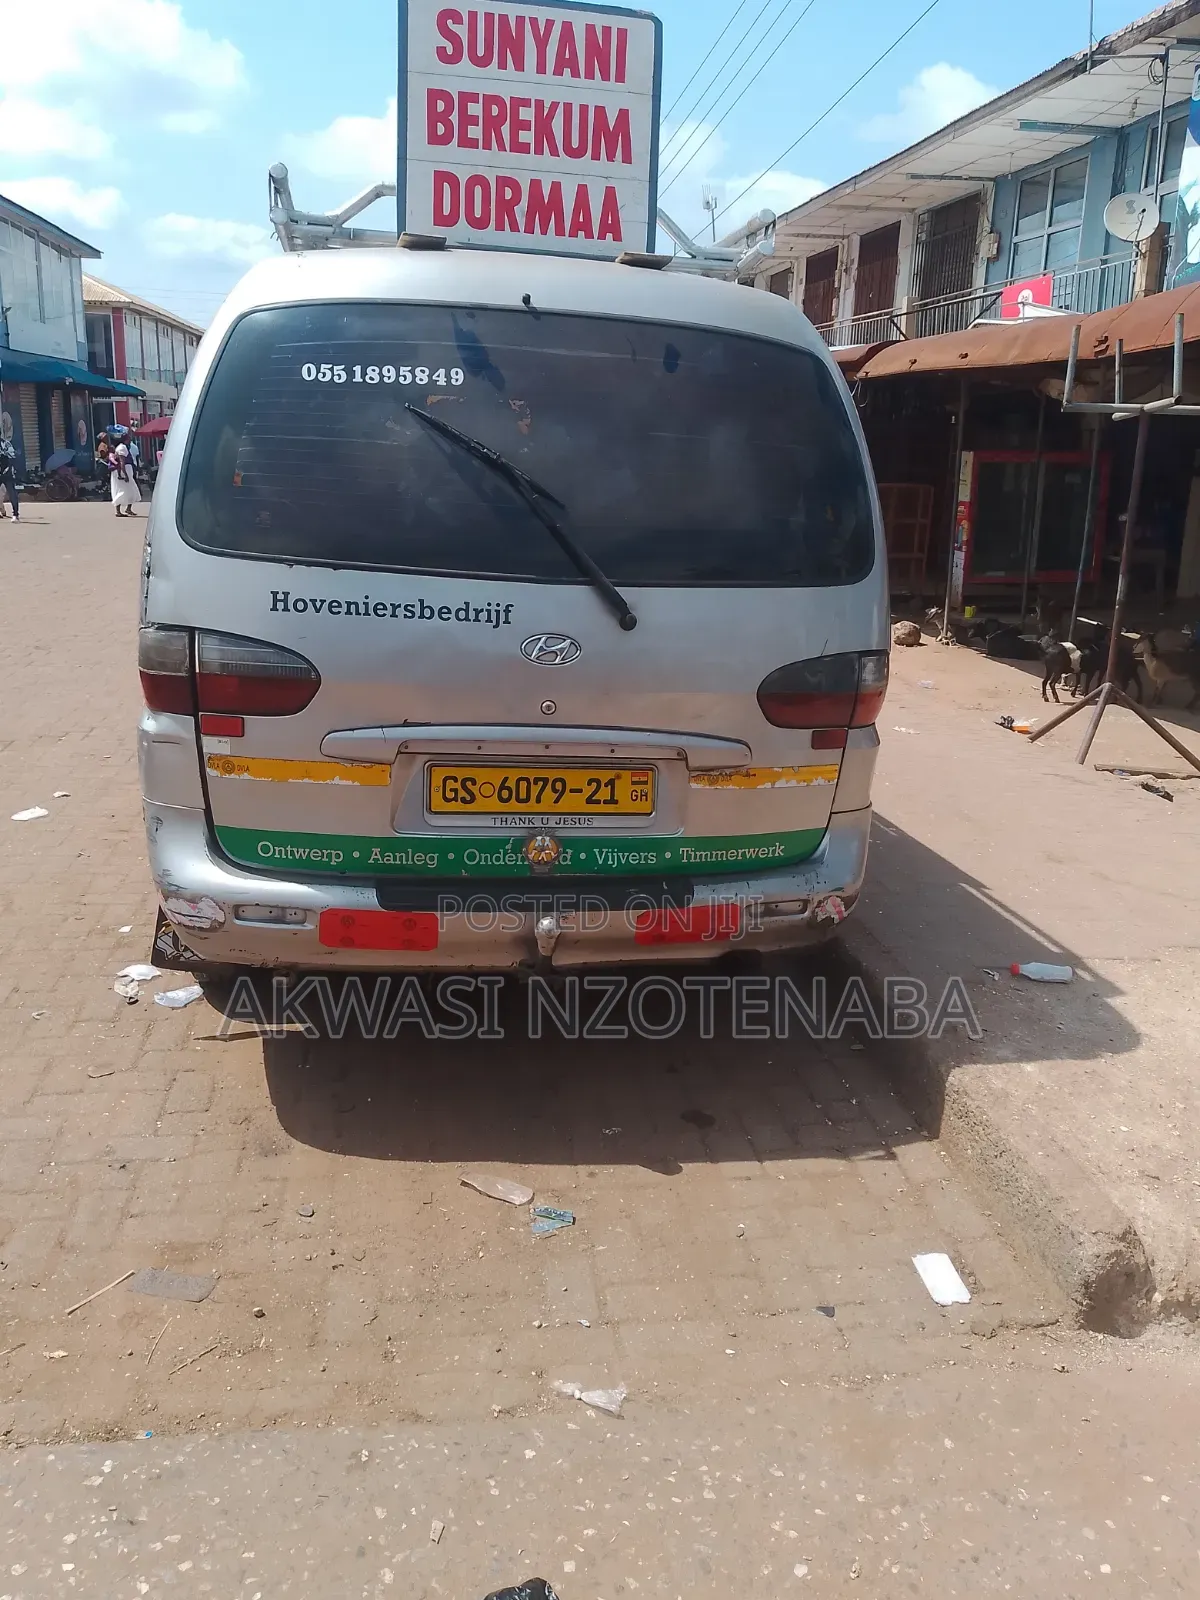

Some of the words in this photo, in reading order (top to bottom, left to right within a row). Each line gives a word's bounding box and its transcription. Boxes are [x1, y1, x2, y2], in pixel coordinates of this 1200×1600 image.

[436, 8, 628, 84] SUNYANI
[426, 87, 633, 165] BEREKUM
[432, 169, 623, 243] DORMAA
[269, 590, 515, 629] Hoveniersbedrijf
[441, 775, 477, 805] GS
[497, 776, 619, 806] 6079-21
[630, 789, 649, 802] GH
[491, 817, 536, 826] THANK
[541, 817, 550, 826] U
[555, 817, 594, 826] JESUS
[256, 841, 344, 864] Ontwerp
[367, 847, 439, 868] Aanleg
[463, 848, 573, 866] Onderd
[593, 848, 657, 867] Vijvers
[679, 843, 785, 863] Timmerwerk
